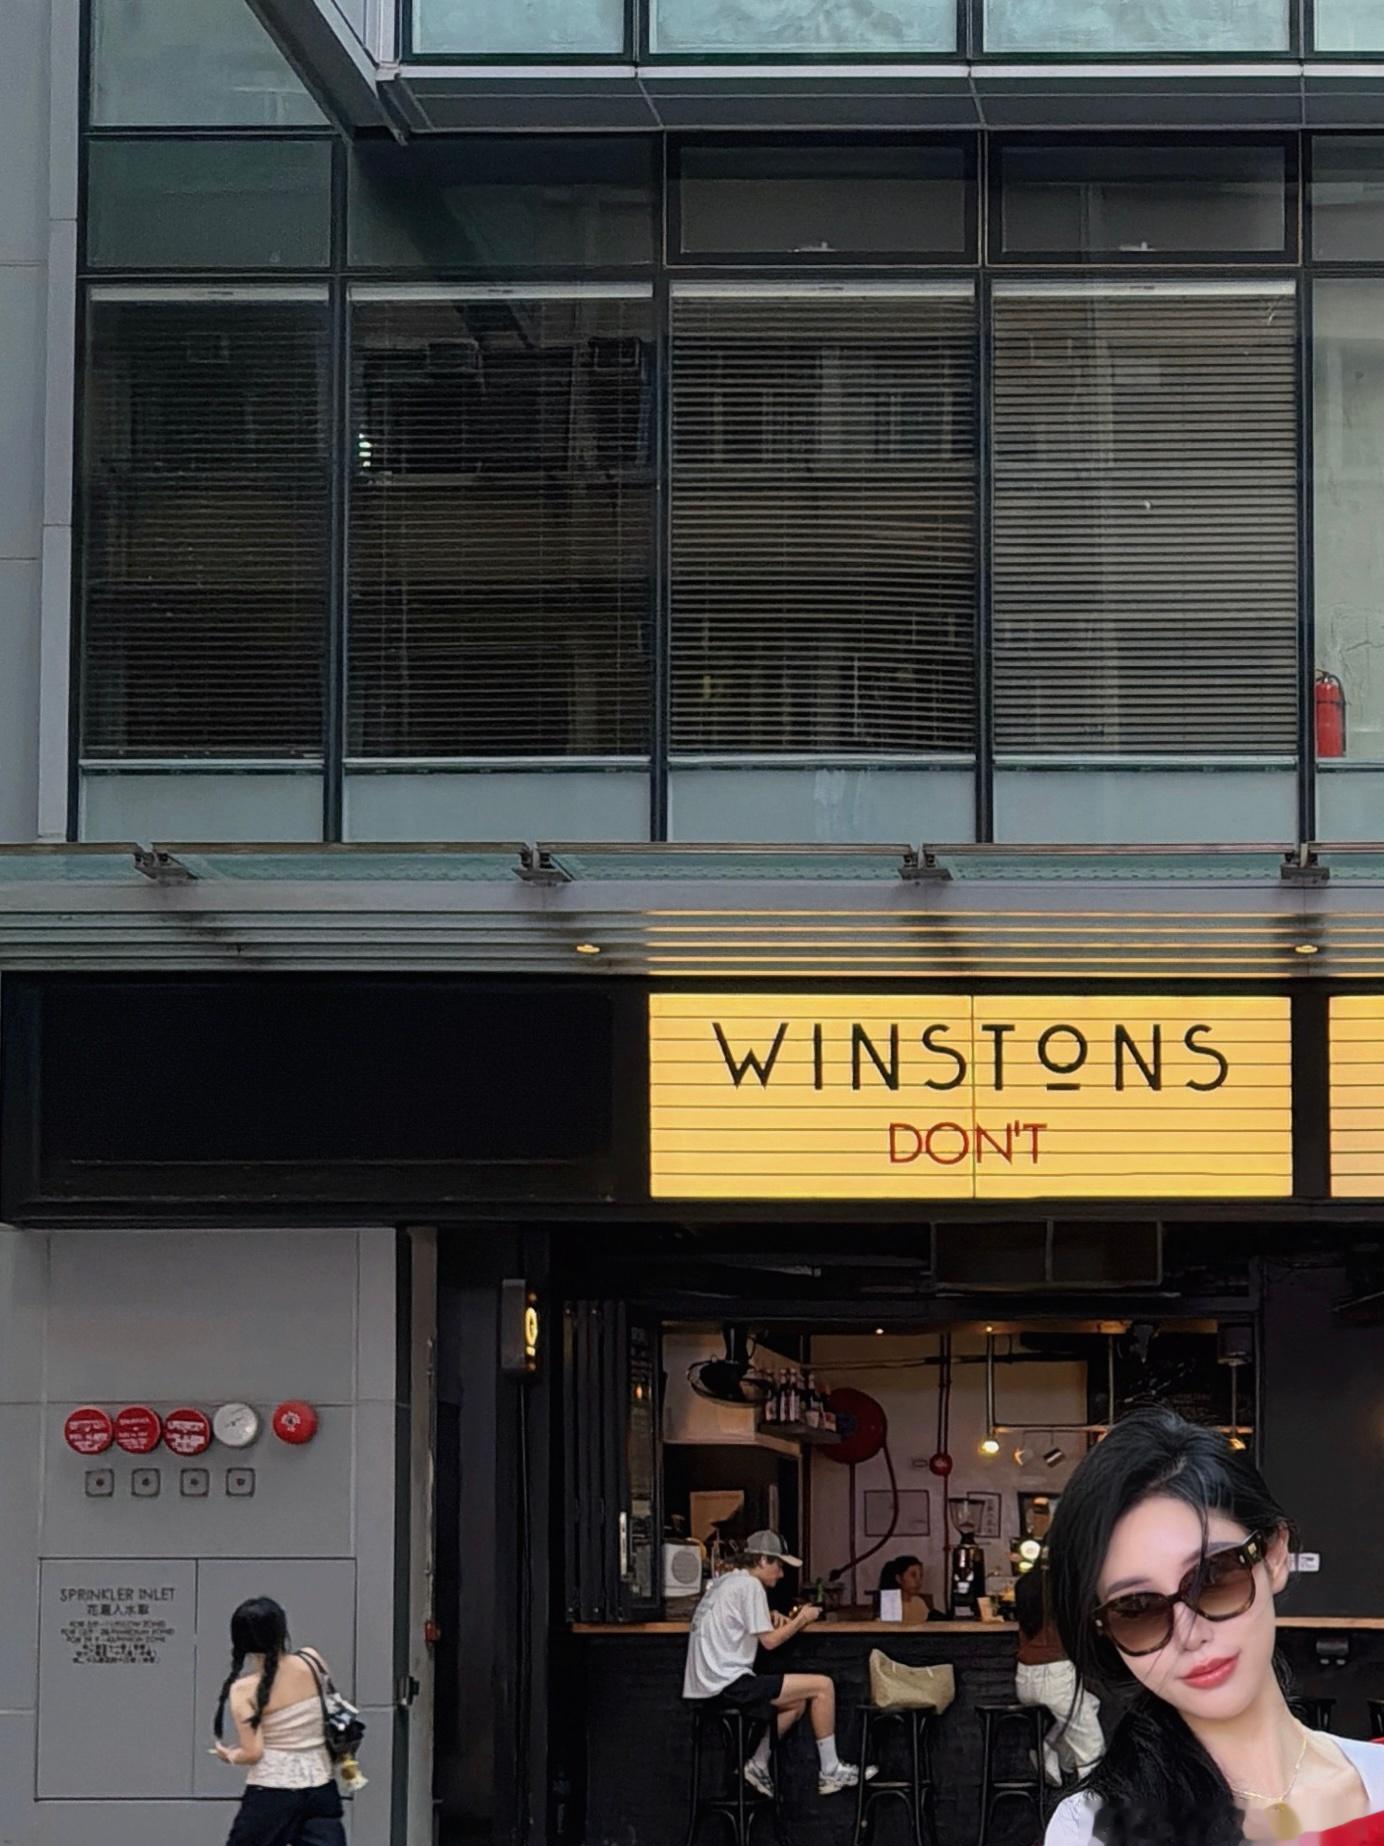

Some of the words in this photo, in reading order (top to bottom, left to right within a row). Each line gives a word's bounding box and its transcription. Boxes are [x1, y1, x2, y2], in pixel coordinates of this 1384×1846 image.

[711, 1022, 1228, 1091] WINSTONS
[889, 1120, 1047, 1165] DON'T
[60, 1587, 134, 1602] SPRINKLER
[139, 1587, 176, 1601] INLET
